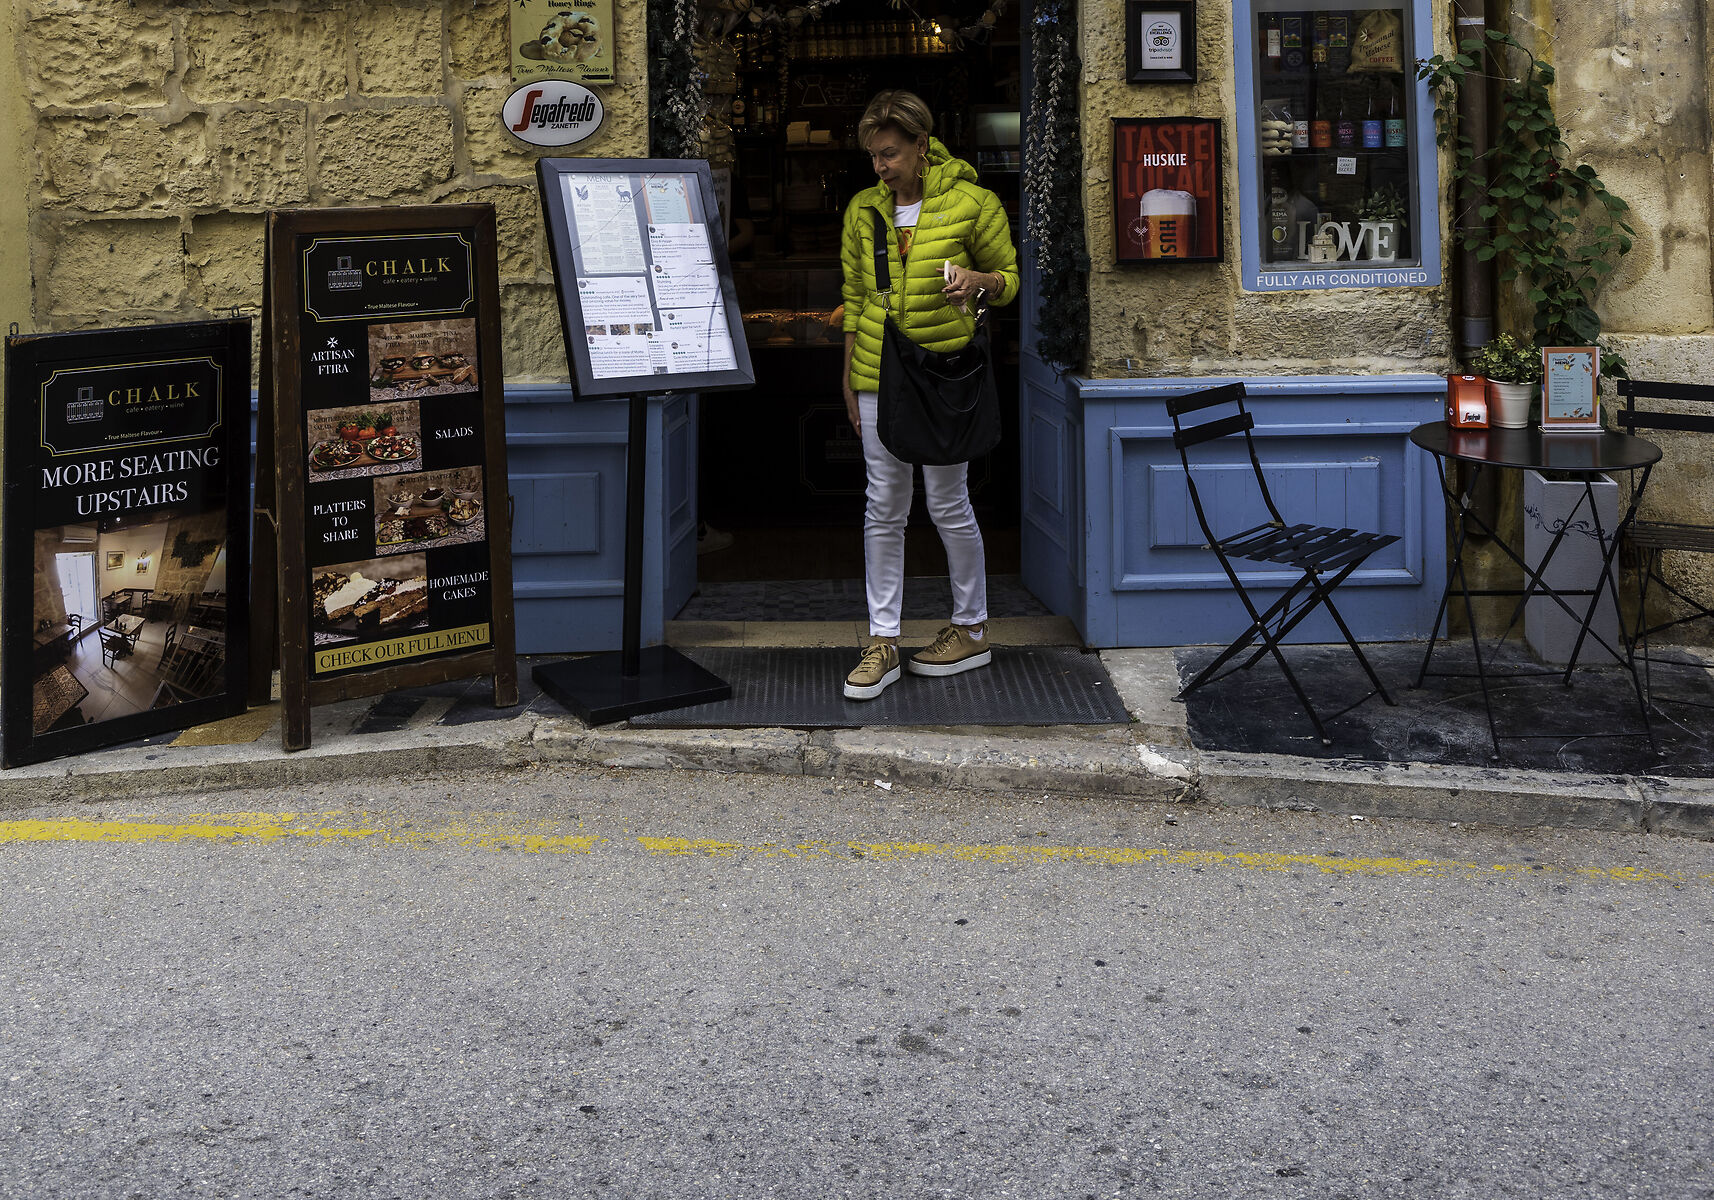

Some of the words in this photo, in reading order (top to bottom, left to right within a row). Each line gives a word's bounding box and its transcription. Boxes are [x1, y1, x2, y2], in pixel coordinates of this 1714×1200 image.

[547, 0, 572, 8] Honey
[574, 0, 596, 8] Rings
[512, 90, 596, 132] Segafredo
[1121, 123, 1209, 162] TASTE
[1143, 153, 1187, 167] HUSKIE
[586, 175, 612, 183] MENU
[1160, 220, 1177, 259] HUS
[1297, 221, 1396, 261] LOVE
[365, 257, 452, 276] CHALK
[1256, 275, 1298, 287] FULLY
[1302, 274, 1326, 286] AIR
[1329, 272, 1428, 286] CONDITIONED
[310, 349, 356, 362] ARTISAN
[317, 364, 349, 376] FTIRA
[108, 381, 200, 406] CHALK
[144, 404, 164, 412] eatery
[435, 426, 474, 440] SALADS
[41, 459, 115, 489] MORE
[119, 446, 221, 479] SEATING
[75, 481, 188, 516] UPSTAIRS
[313, 499, 366, 515] PLATTERS
[332, 516, 348, 527] TO
[323, 528, 359, 543] SHARE
[429, 570, 489, 589] HOMEMADE
[442, 587, 477, 601] CAKES
[320, 648, 372, 669] CHECK
[375, 642, 406, 659] OUR
[409, 636, 445, 653] FULL
[446, 628, 486, 647] MENU
